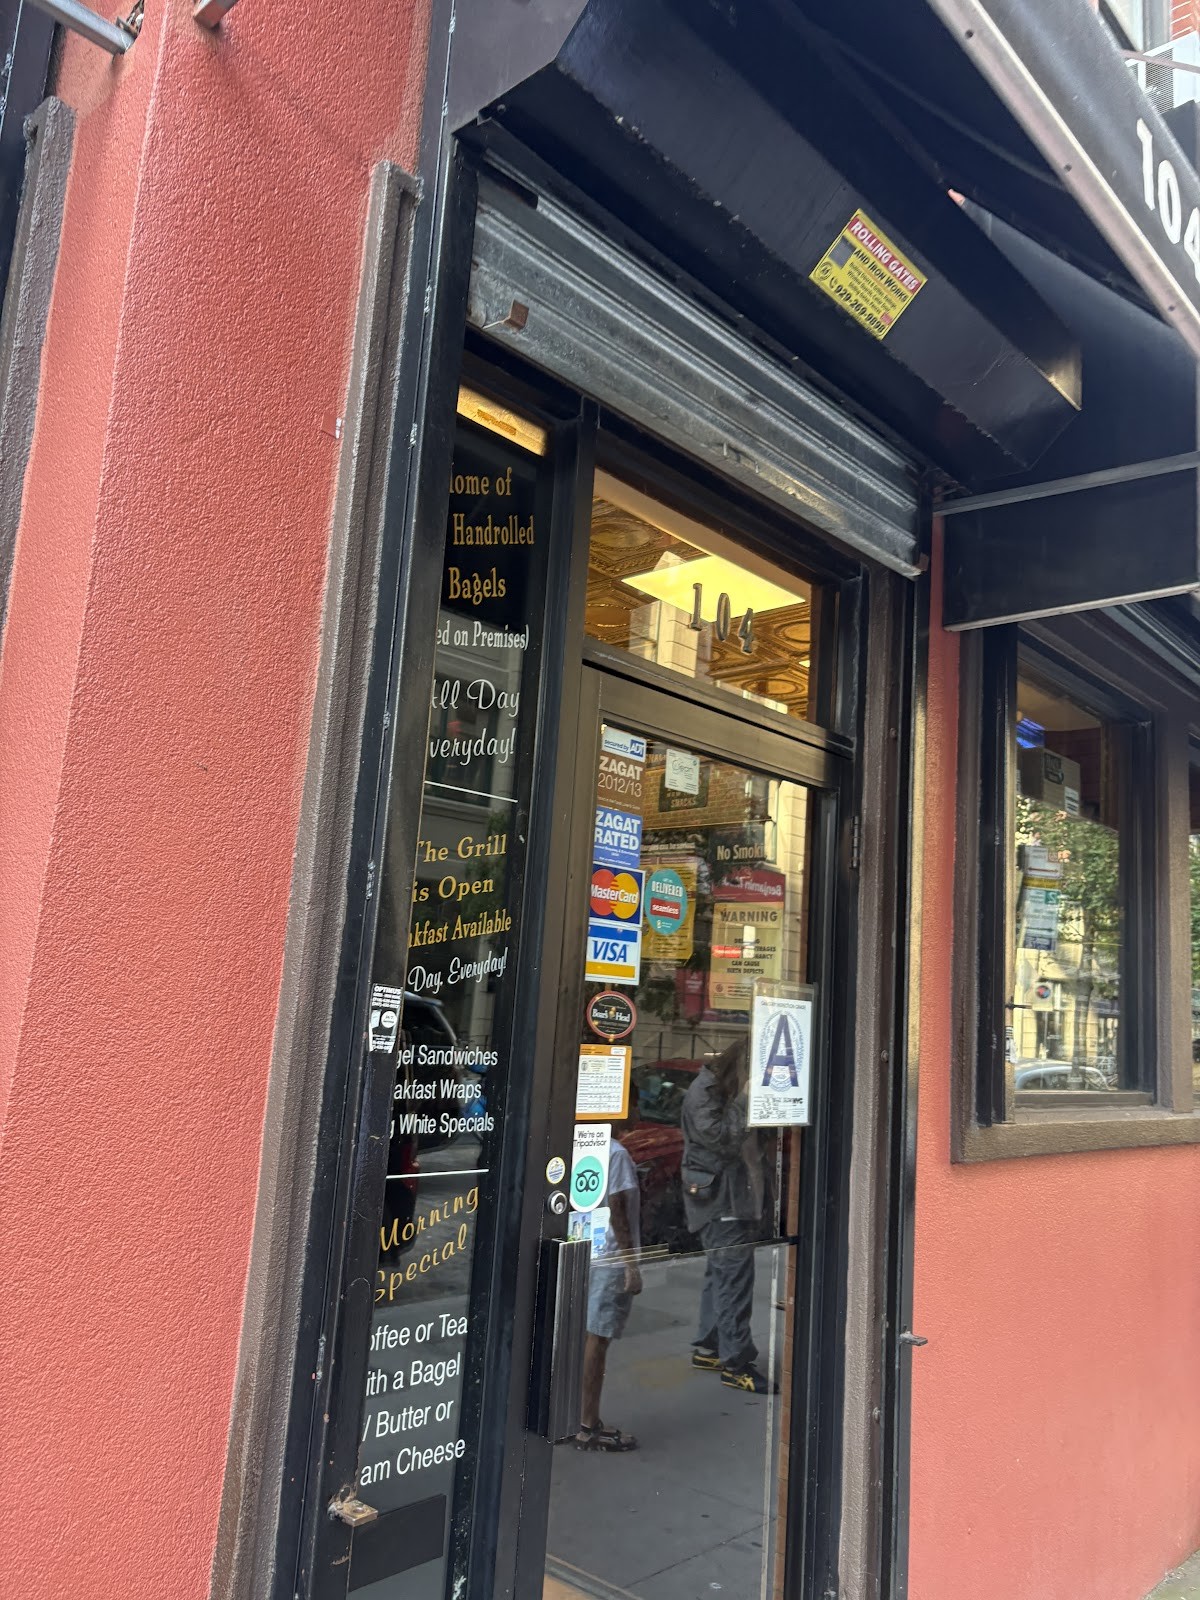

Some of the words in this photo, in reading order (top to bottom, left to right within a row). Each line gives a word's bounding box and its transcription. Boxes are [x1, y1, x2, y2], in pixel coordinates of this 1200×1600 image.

[851, 221, 892, 264] ROLLING
[888, 260, 919, 291] GATES
[854, 249, 870, 265] AND
[868, 261, 886, 281] IRON
[885, 276, 908, 302] WORKS
[495, 466, 513, 496] of
[453, 513, 535, 545] Handrolled
[448, 566, 506, 606] Bagels
[688, 582, 754, 654] 104
[454, 629, 468, 647] on
[472, 620, 530, 651] Premises)
[467, 678, 520, 718] Day
[429, 727, 517, 766] veryday!
[598, 755, 643, 781] ZAGAT
[597, 772, 642, 798] 2012/13
[595, 810, 640, 835] ZAGAT
[457, 833, 507, 859] Grill
[594, 828, 639, 851] RATED
[716, 845, 731, 861] No
[733, 843, 766, 860] Smoki
[412, 881, 430, 903] is
[438, 875, 494, 902] Open
[590, 884, 639, 904] MasterCard
[651, 881, 684, 898] DELIVERED
[652, 903, 680, 915] seamless
[720, 911, 779, 923] WARNING
[451, 908, 512, 941] Available
[447, 947, 509, 985] Everyday!
[592, 940, 628, 963] VISA
[417, 1044, 499, 1067] Sandwiches
[762, 1014, 799, 1087] A
[393, 1079, 437, 1100] akfast
[439, 1078, 482, 1104] Wraps
[399, 1113, 437, 1135] White
[439, 1111, 495, 1139] Specials
[415, 1321, 435, 1344] or
[438, 1313, 469, 1339] Tea
[365, 1368, 388, 1397] ith
[392, 1370, 405, 1390] a
[409, 1352, 461, 1387] Bagel
[375, 1405, 432, 1438] Butter
[435, 1400, 455, 1422] or
[359, 1459, 391, 1487] am
[396, 1438, 467, 1476] Cheese
